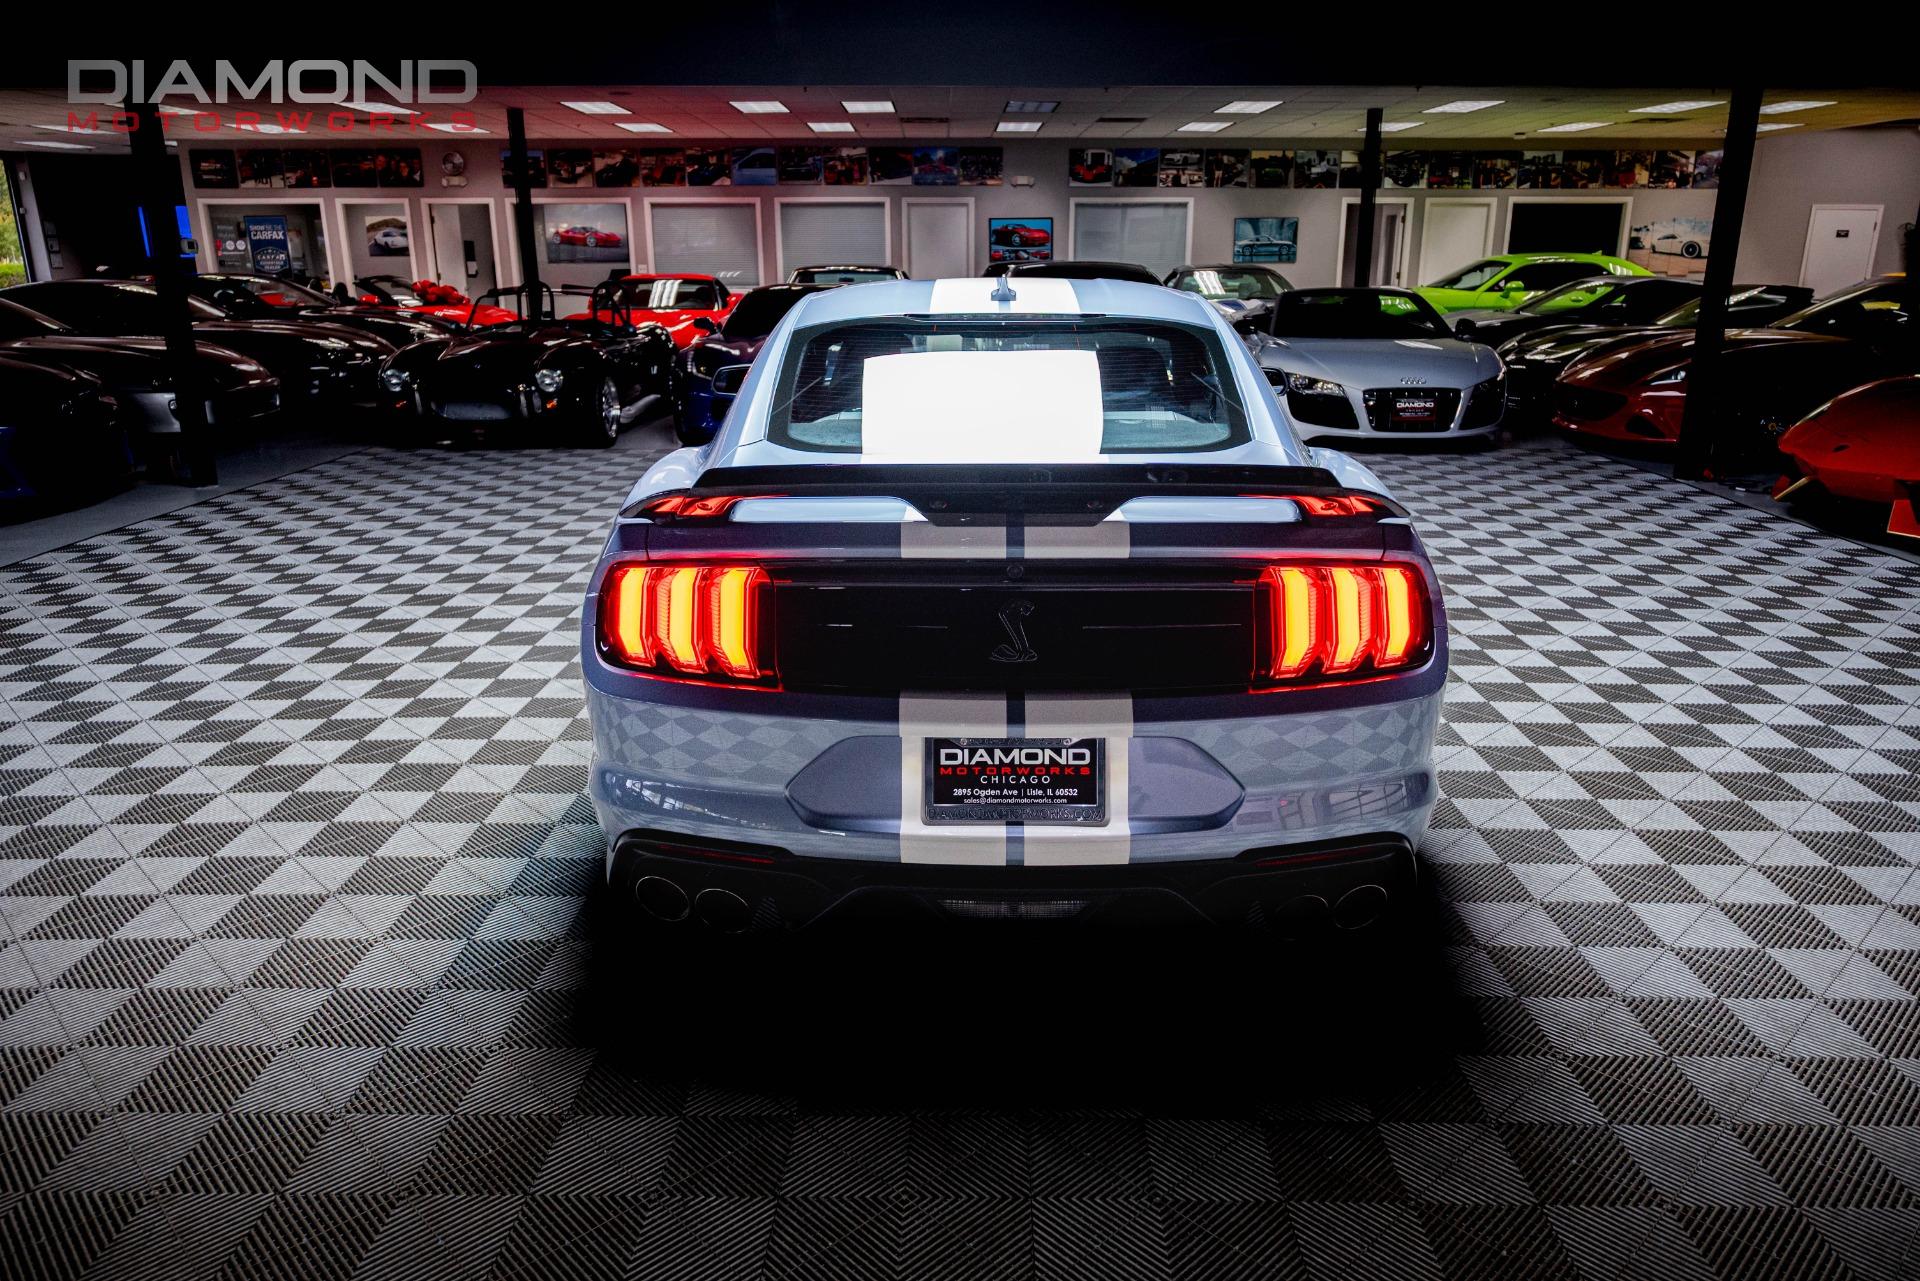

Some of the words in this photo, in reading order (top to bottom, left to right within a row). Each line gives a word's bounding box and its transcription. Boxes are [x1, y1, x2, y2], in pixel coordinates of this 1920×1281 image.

[250, 231, 284, 240] CARFAX
[940, 748, 1090, 765] DIAMOND
[940, 766, 1090, 775] MOTORWORKS
[980, 775, 1051, 784] CHICAGO
[953, 788, 971, 796] 2895
[973, 788, 1001, 798] Ogden
[1002, 788, 1018, 796] Ave
[1027, 788, 1045, 797] Lisle,
[1046, 788, 1053, 796] IL
[1055, 788, 1078, 796] 60532
[963, 796, 1068, 804] sales@diamondmotorworks.com
